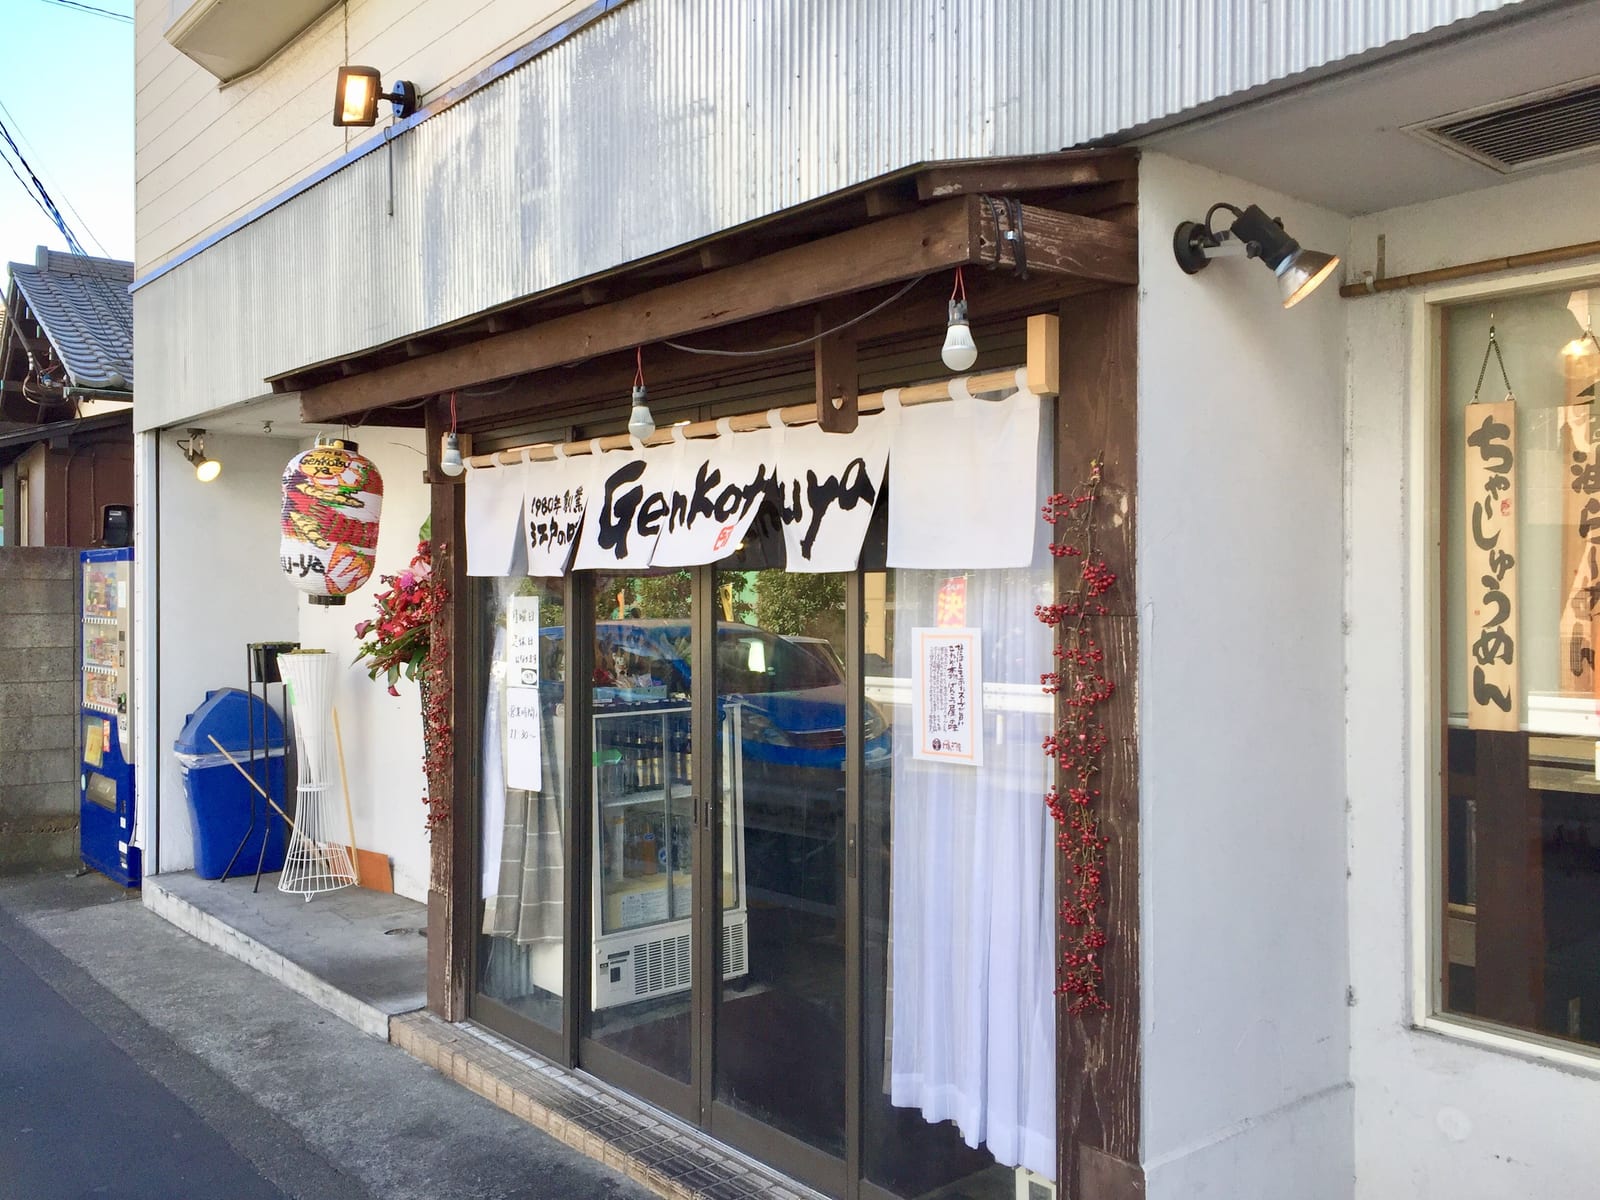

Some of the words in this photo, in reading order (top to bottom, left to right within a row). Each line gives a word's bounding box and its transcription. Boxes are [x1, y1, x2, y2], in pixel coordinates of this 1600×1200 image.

[313, 466, 333, 475] ya
[531, 486, 583, 517] 1980年創業
